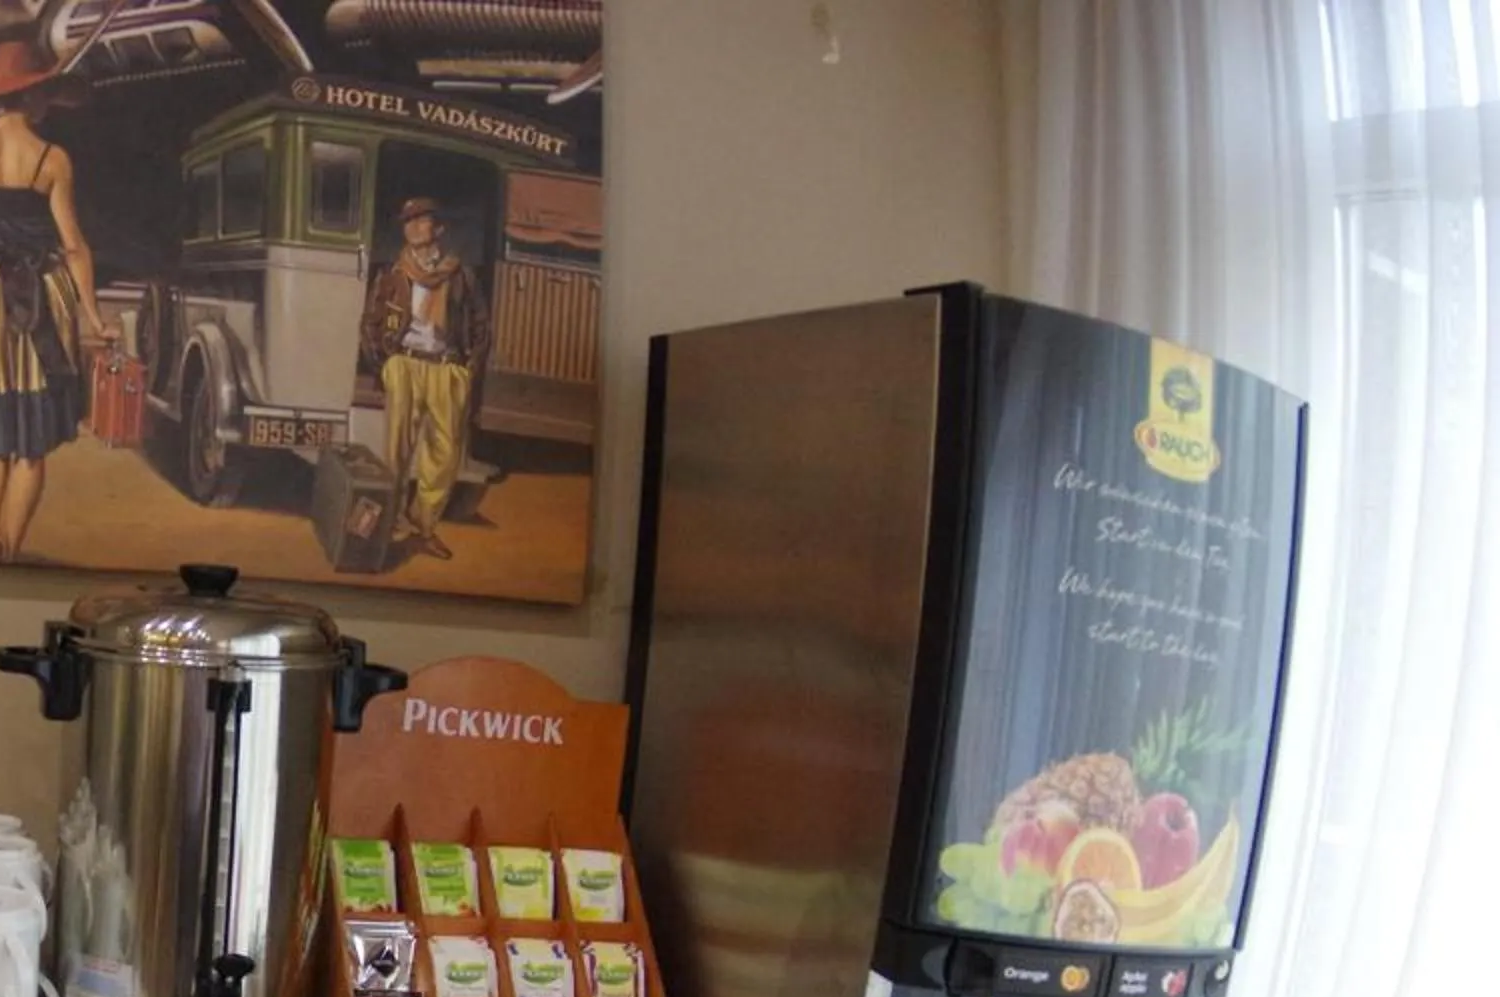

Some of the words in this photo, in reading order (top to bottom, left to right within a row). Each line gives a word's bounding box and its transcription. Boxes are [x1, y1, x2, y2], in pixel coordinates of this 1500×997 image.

[326, 84, 410, 116] HOTEL
[1159, 430, 1209, 463] RAUCH
[402, 697, 565, 745] PICKWICK
[1003, 965, 1049, 984] Orange
